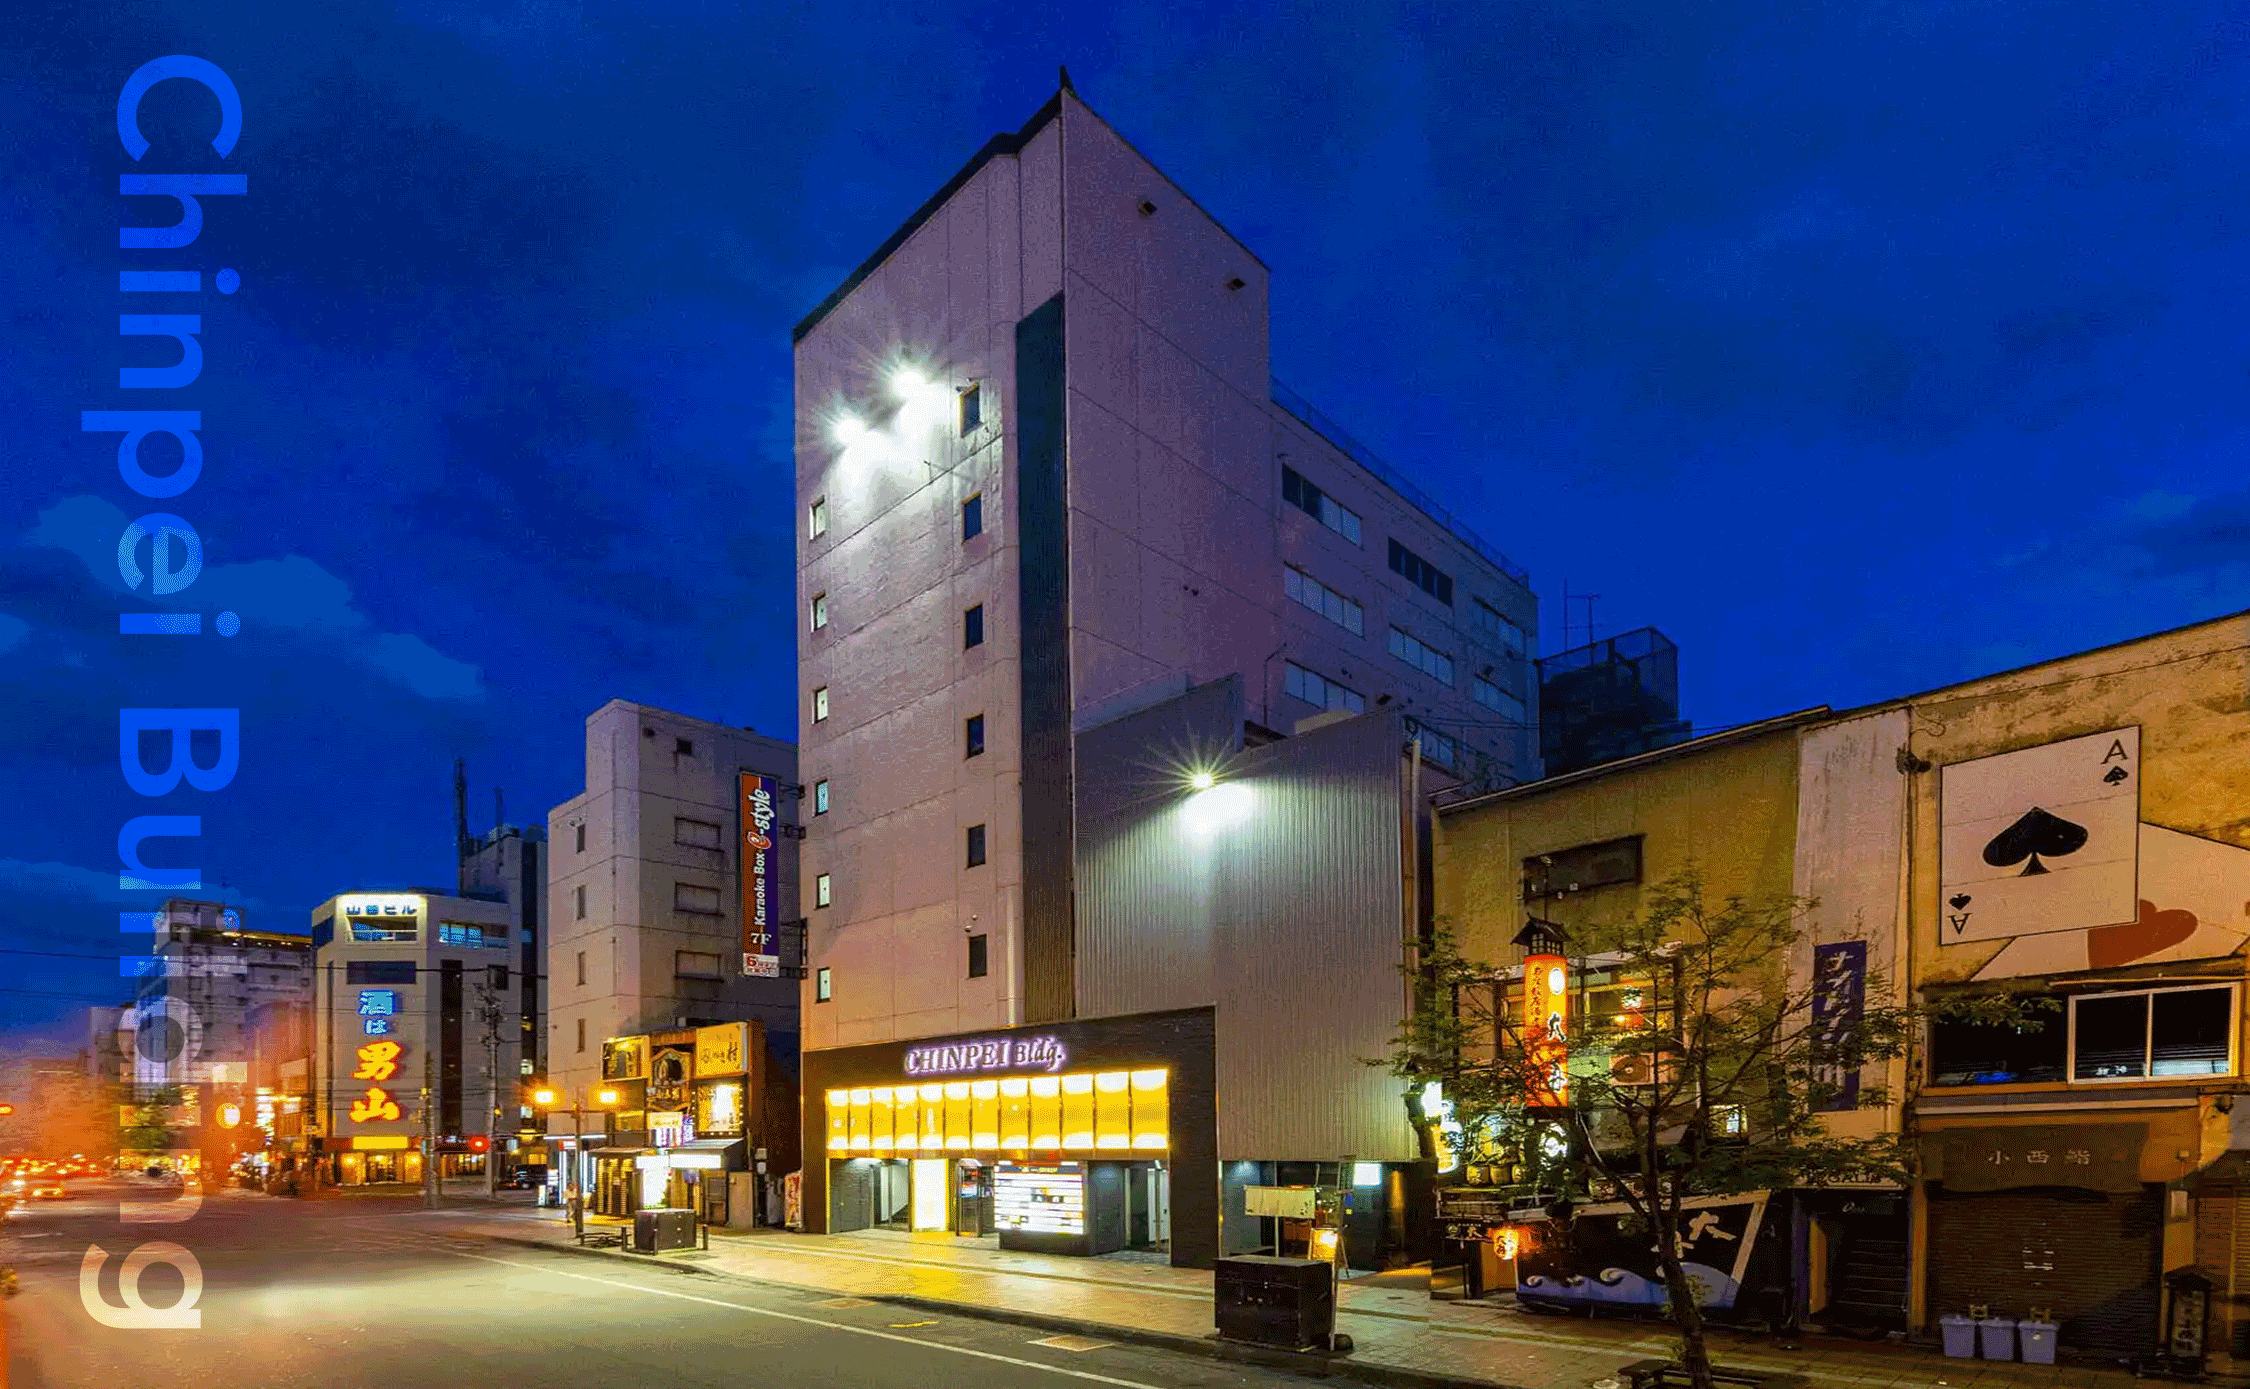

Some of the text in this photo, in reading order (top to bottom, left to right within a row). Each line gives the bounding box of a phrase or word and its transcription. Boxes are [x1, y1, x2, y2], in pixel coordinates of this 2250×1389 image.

[2101, 739, 2127, 764] A
[754, 852, 765, 875] Box
[754, 877, 766, 926] Karaoke
[750, 932, 772, 945] 7F
[904, 1036, 1066, 1075] CHINPEI Bldg.
